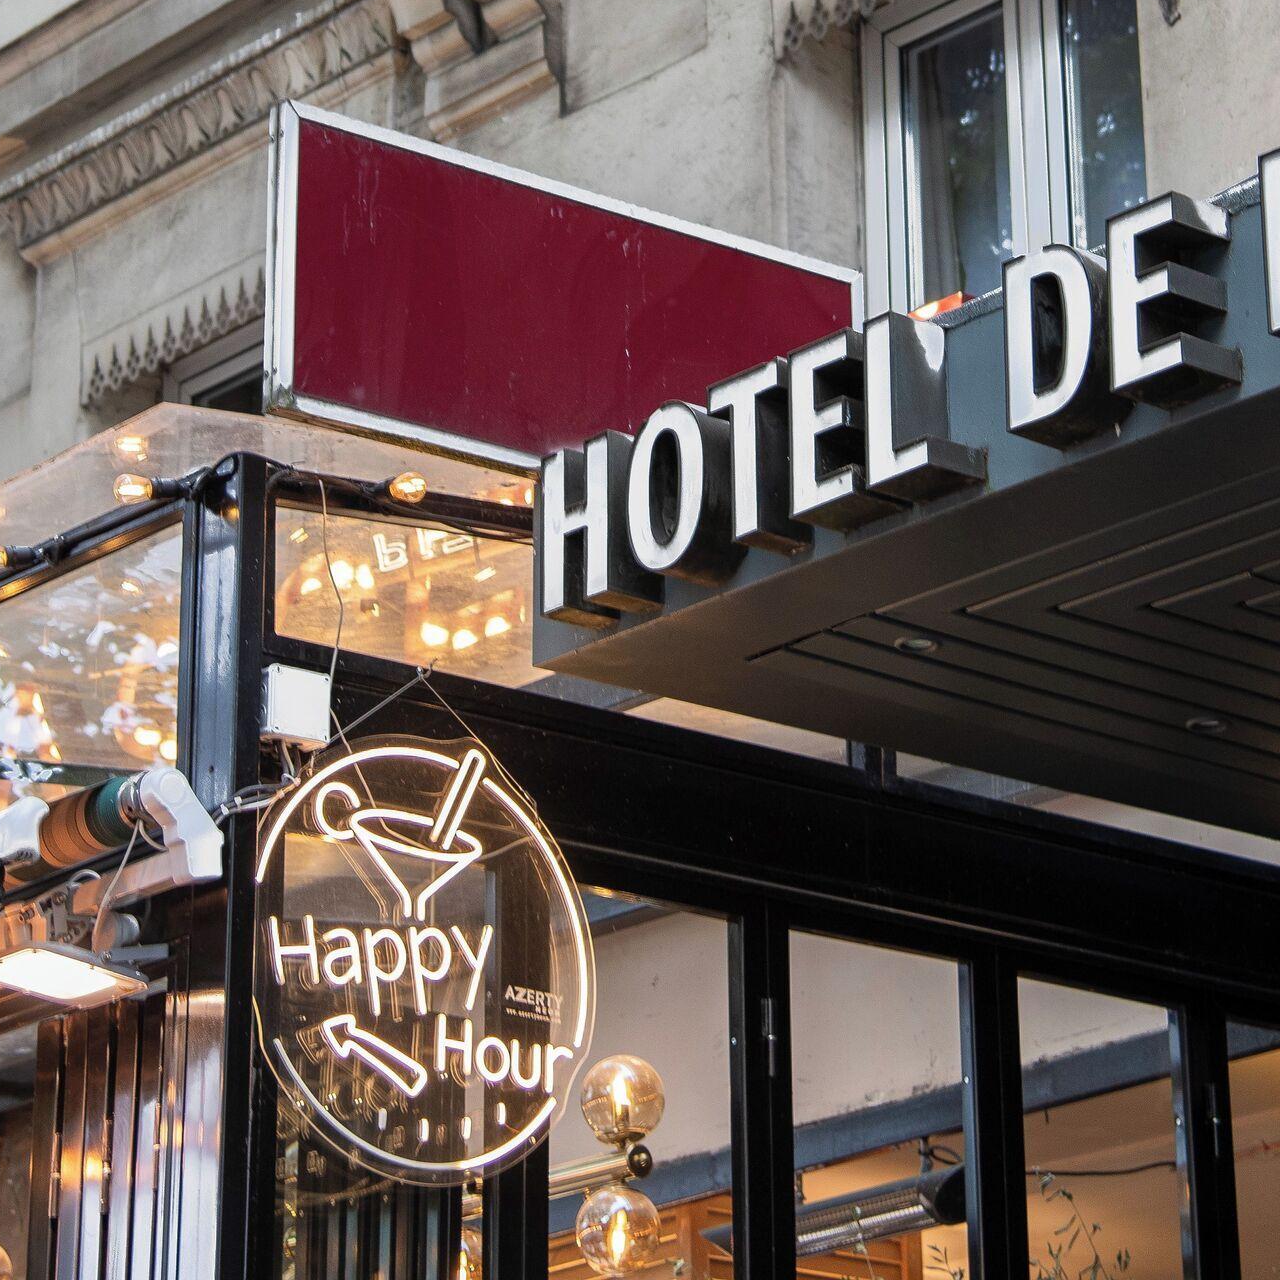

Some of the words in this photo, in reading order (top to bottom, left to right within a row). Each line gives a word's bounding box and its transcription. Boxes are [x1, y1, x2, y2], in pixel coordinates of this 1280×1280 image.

[540, 312, 930, 618] HOTEL
[1003, 190, 1190, 433] DE
[268, 914, 494, 1016] Happy
[504, 984, 563, 1008] AZERTY
[434, 1013, 574, 1094] Hour
